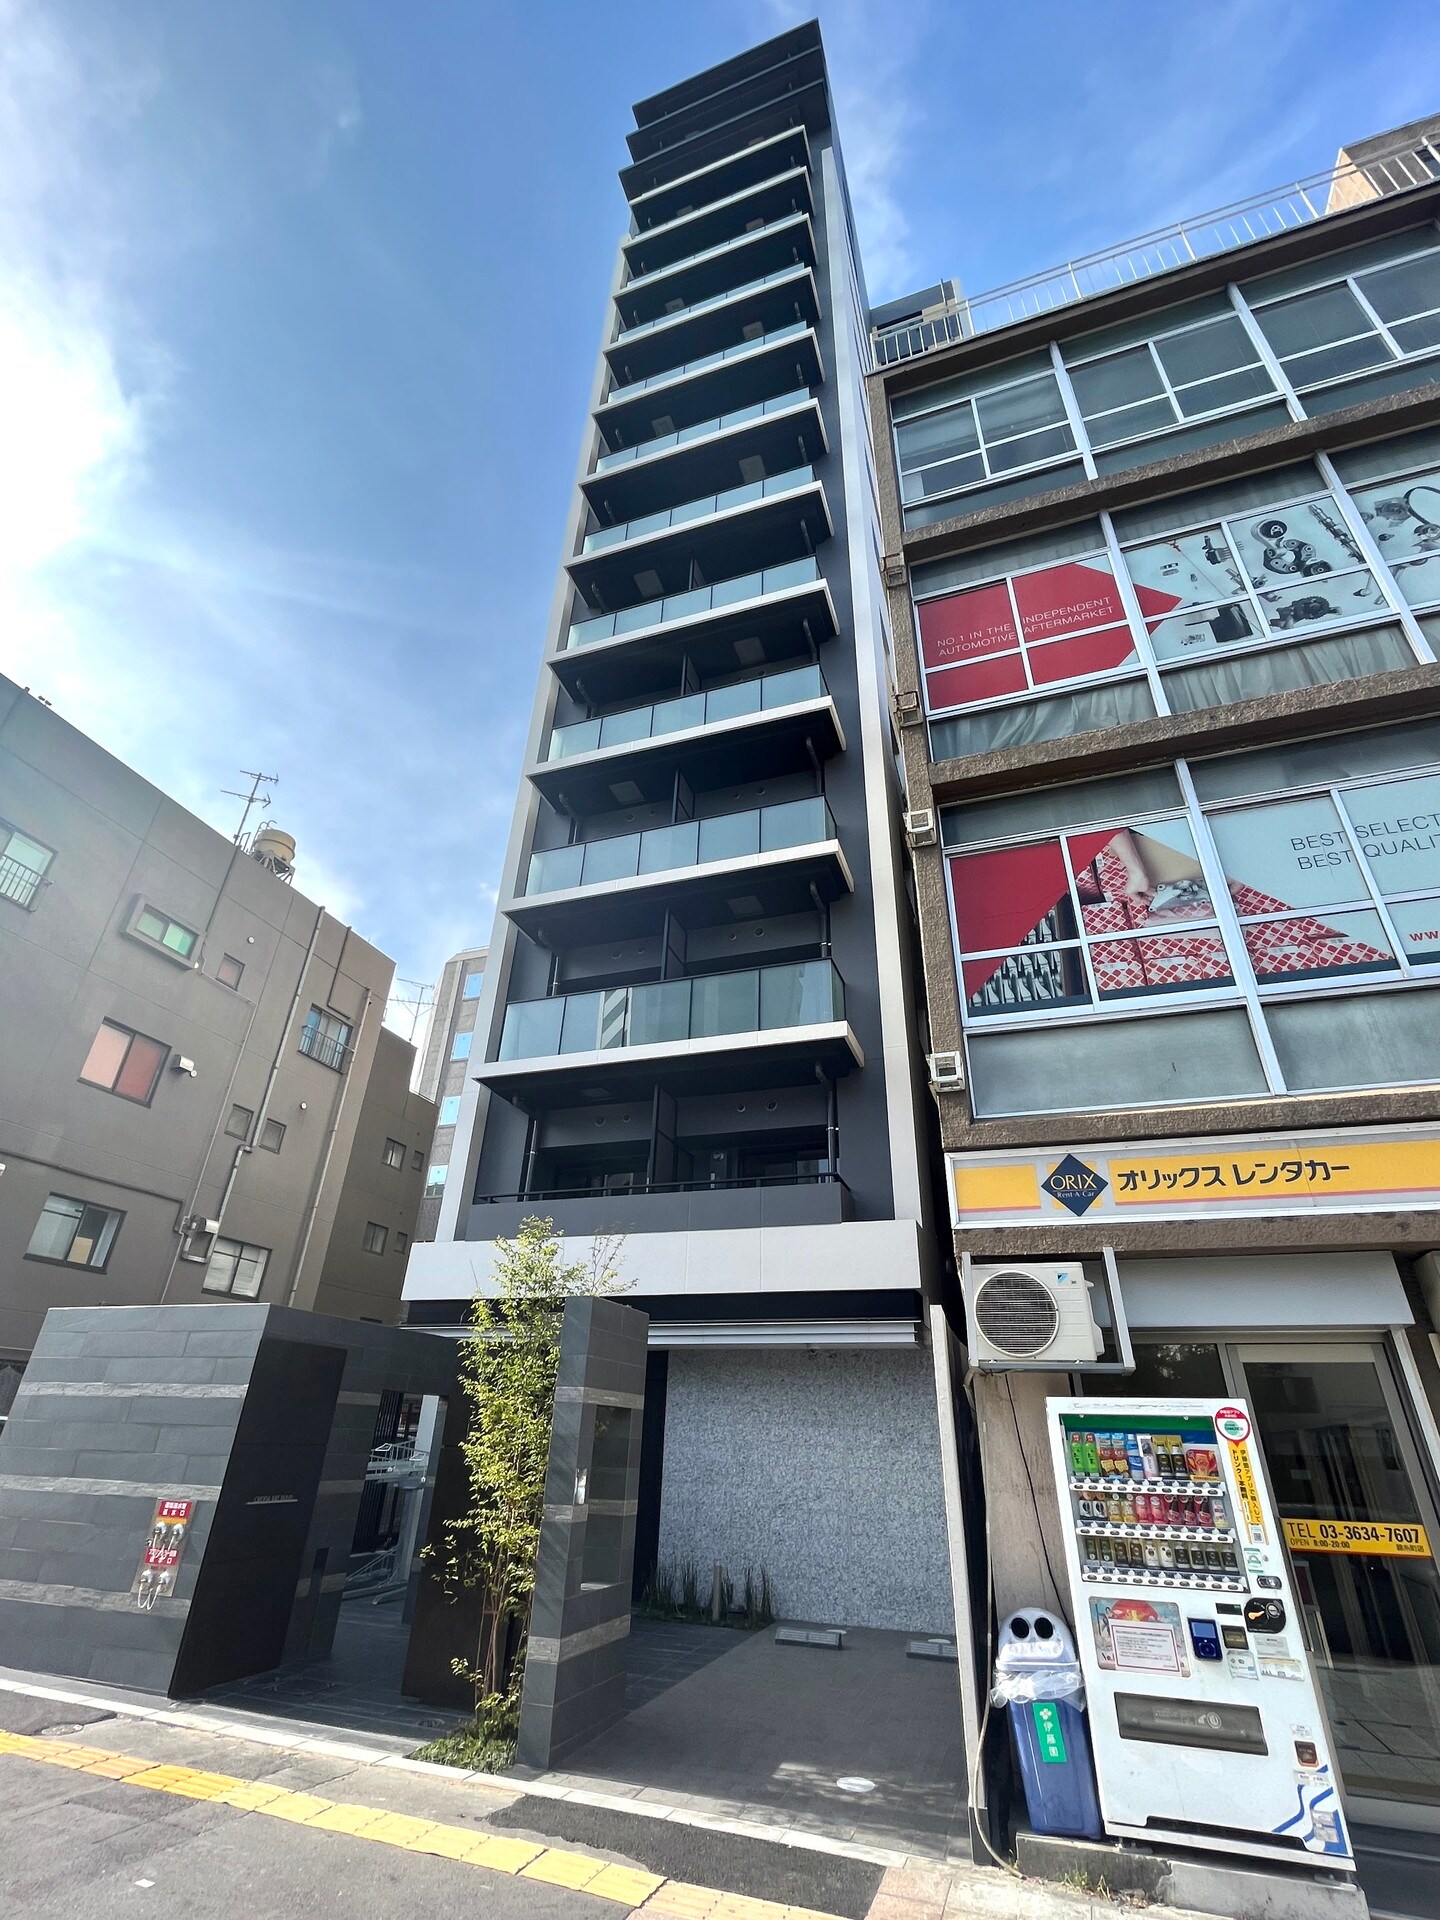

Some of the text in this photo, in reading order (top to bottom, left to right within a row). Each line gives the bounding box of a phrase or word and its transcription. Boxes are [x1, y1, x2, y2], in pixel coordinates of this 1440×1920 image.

[969, 630, 982, 640] IN
[988, 623, 1012, 636] THE
[1022, 597, 1111, 624] INDEPENDENT
[938, 605, 1115, 657] AUTOMOTIVE AFTERMARKET
[1290, 830, 1346, 851] BEST
[1297, 850, 1352, 870] BEST
[1050, 1173, 1098, 1190] ORIX
[1117, 1159, 1350, 1191] オリックス レンタカー
[1287, 1522, 1419, 1543] TEL 03-3634-7607
[1290, 1538, 1350, 1548] OPEN 8:00-20:00
